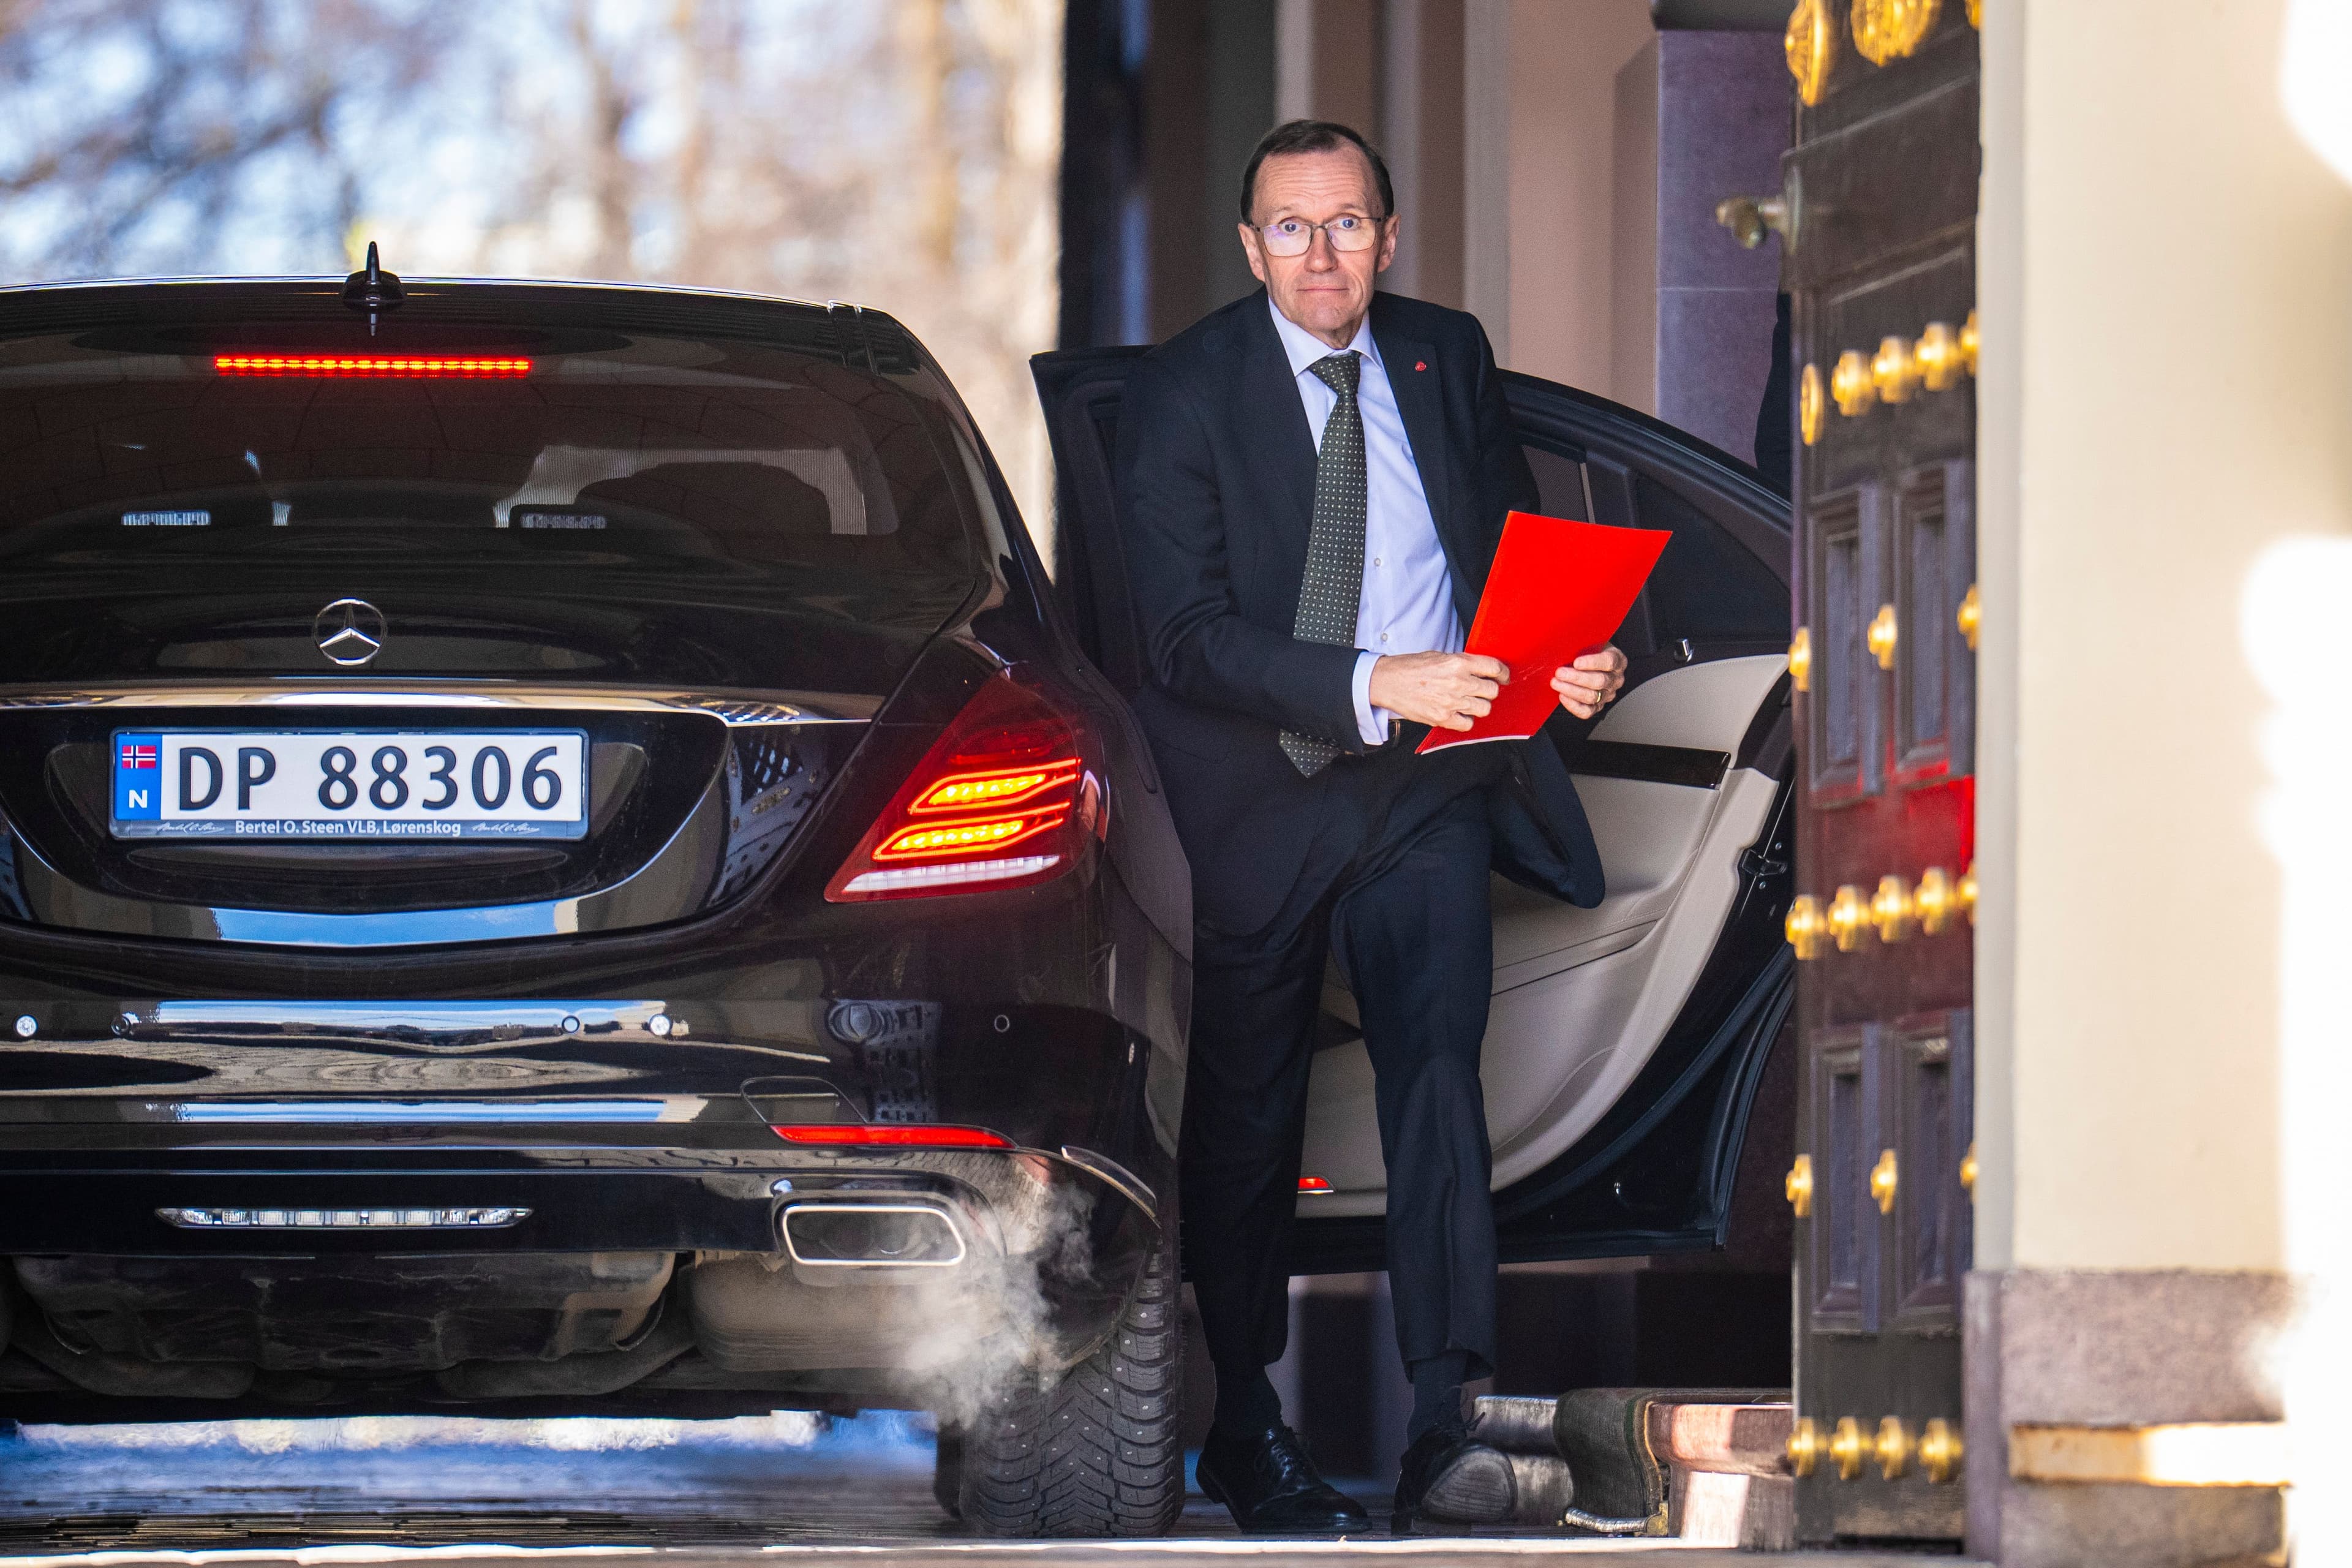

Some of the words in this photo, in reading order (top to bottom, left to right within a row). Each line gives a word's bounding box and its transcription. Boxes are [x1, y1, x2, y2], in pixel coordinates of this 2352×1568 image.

[179, 747, 277, 811] DP
[317, 745, 562, 810] 88306
[128, 790, 148, 809] N
[235, 820, 280, 834] Bertel
[283, 820, 300, 834] O.
[301, 820, 344, 834] Steen
[347, 820, 380, 835] VLB,
[383, 820, 461, 837] Lørenskog
